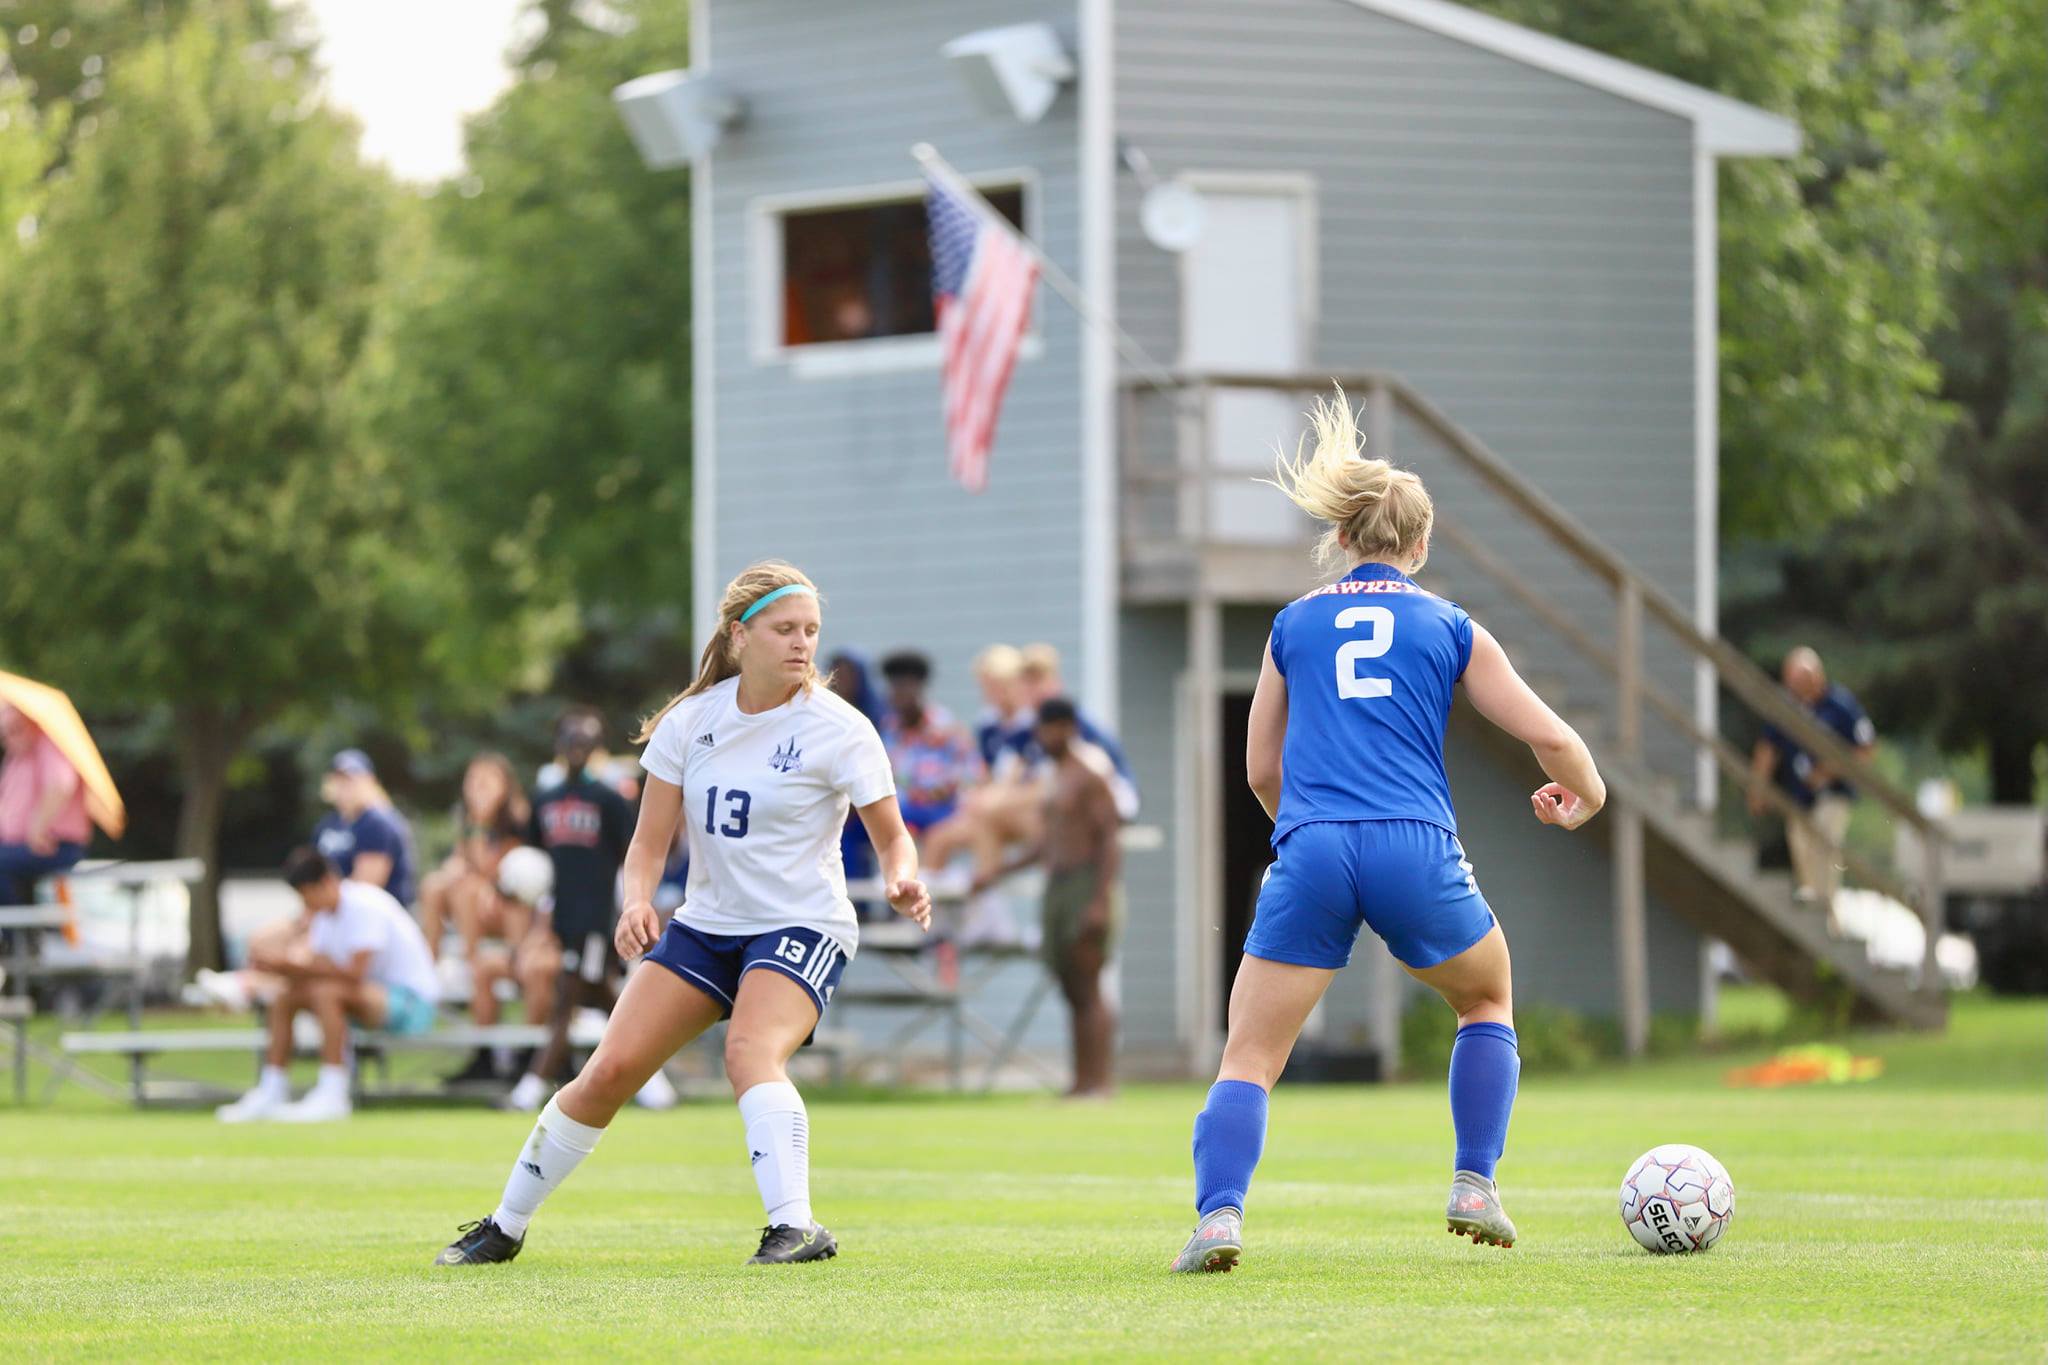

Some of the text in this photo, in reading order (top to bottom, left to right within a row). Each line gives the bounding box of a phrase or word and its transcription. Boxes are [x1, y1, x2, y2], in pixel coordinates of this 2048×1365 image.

[1335, 606, 1395, 700] 2
[705, 785, 751, 838] 13
[775, 936, 807, 964] 13
